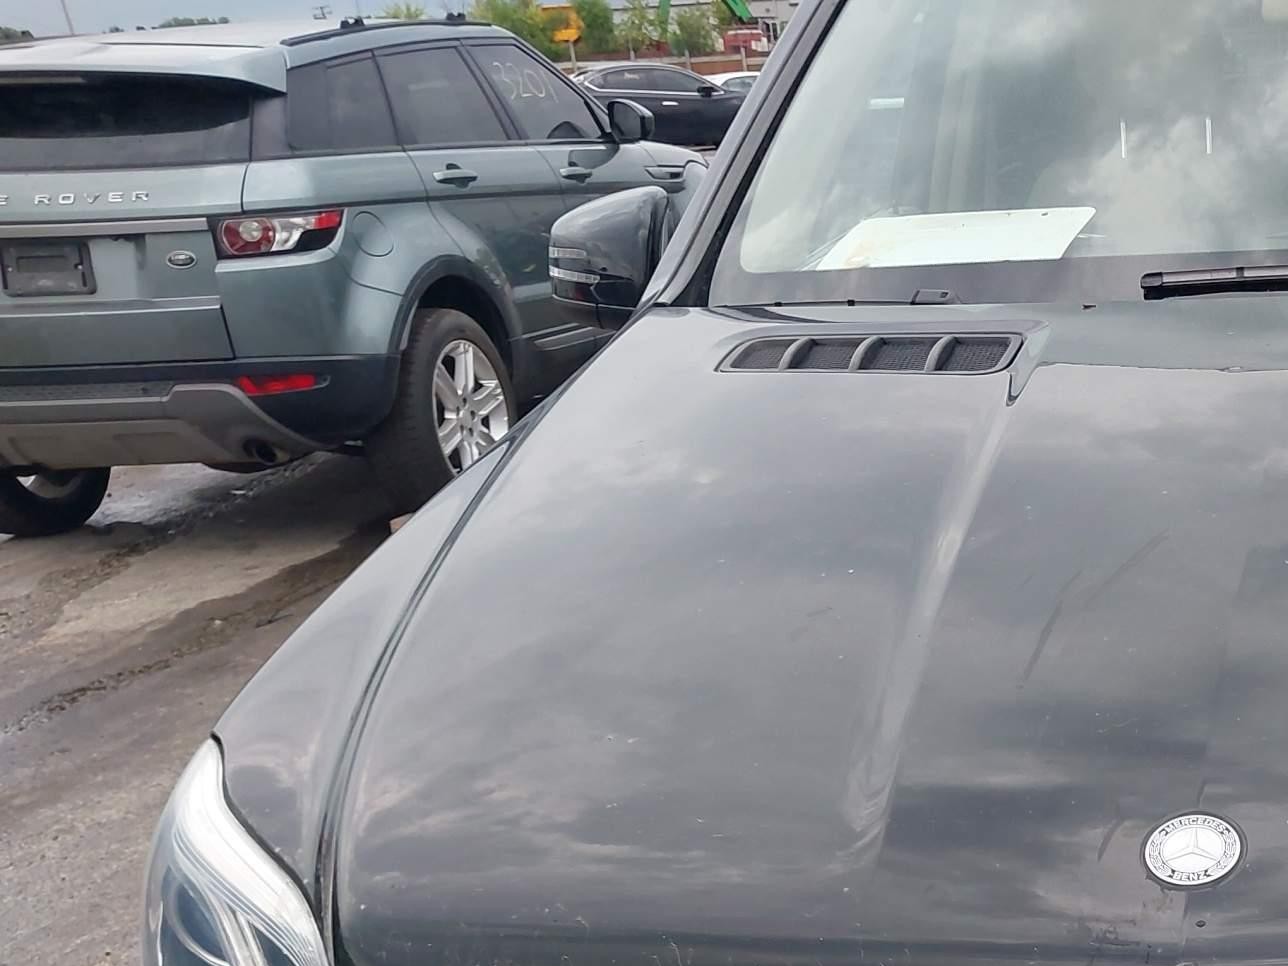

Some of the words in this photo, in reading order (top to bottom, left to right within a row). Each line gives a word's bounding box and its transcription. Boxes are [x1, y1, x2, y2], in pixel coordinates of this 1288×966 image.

[492, 61, 560, 104] 3201
[33, 190, 150, 206] ROVER
[1165, 816, 1227, 835] MERCEDES
[1171, 870, 1209, 882] BENZ
